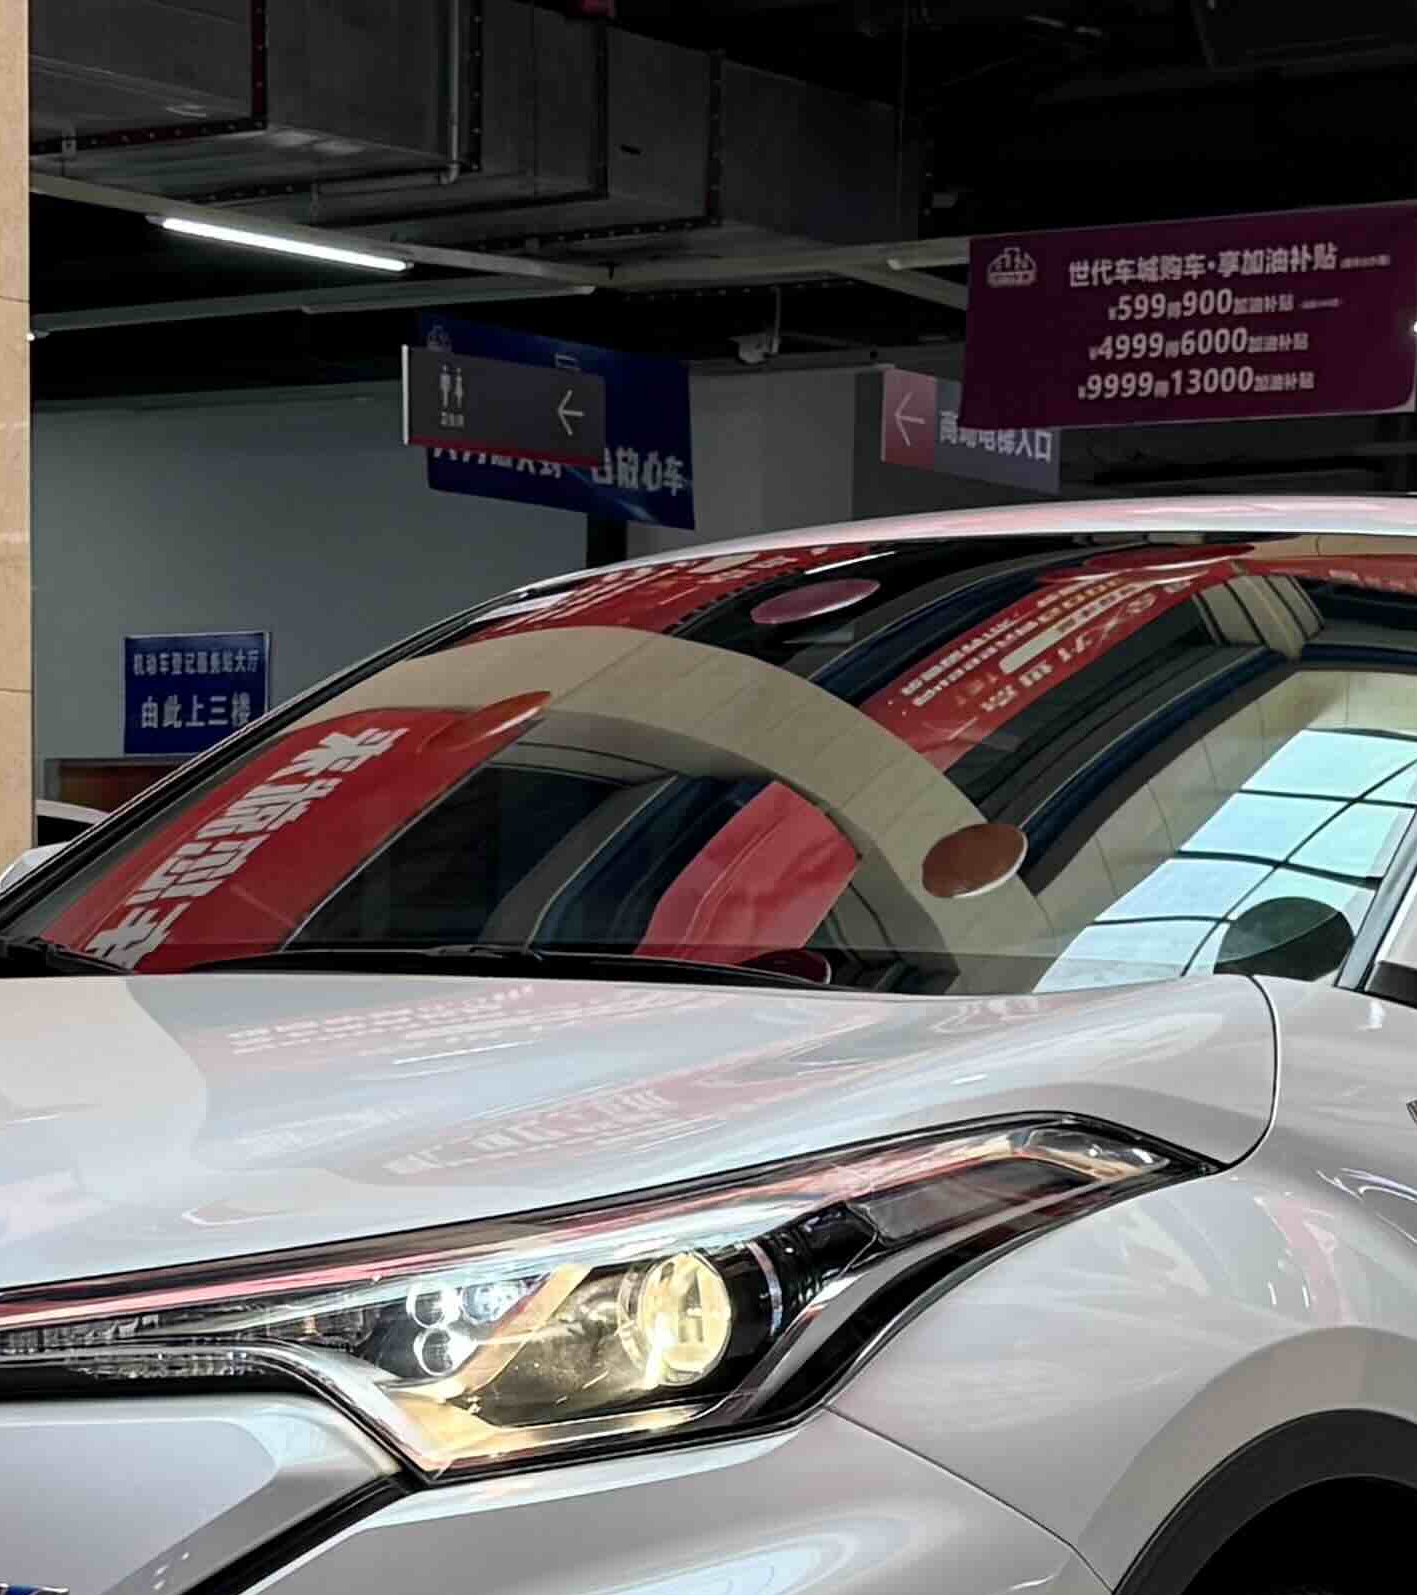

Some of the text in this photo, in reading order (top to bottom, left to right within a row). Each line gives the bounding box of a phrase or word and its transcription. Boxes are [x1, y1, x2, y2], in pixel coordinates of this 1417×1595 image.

[1069, 242, 1338, 287] 世代车城购车·享加油补贴
[140, 692, 252, 730] 由此上三楼
